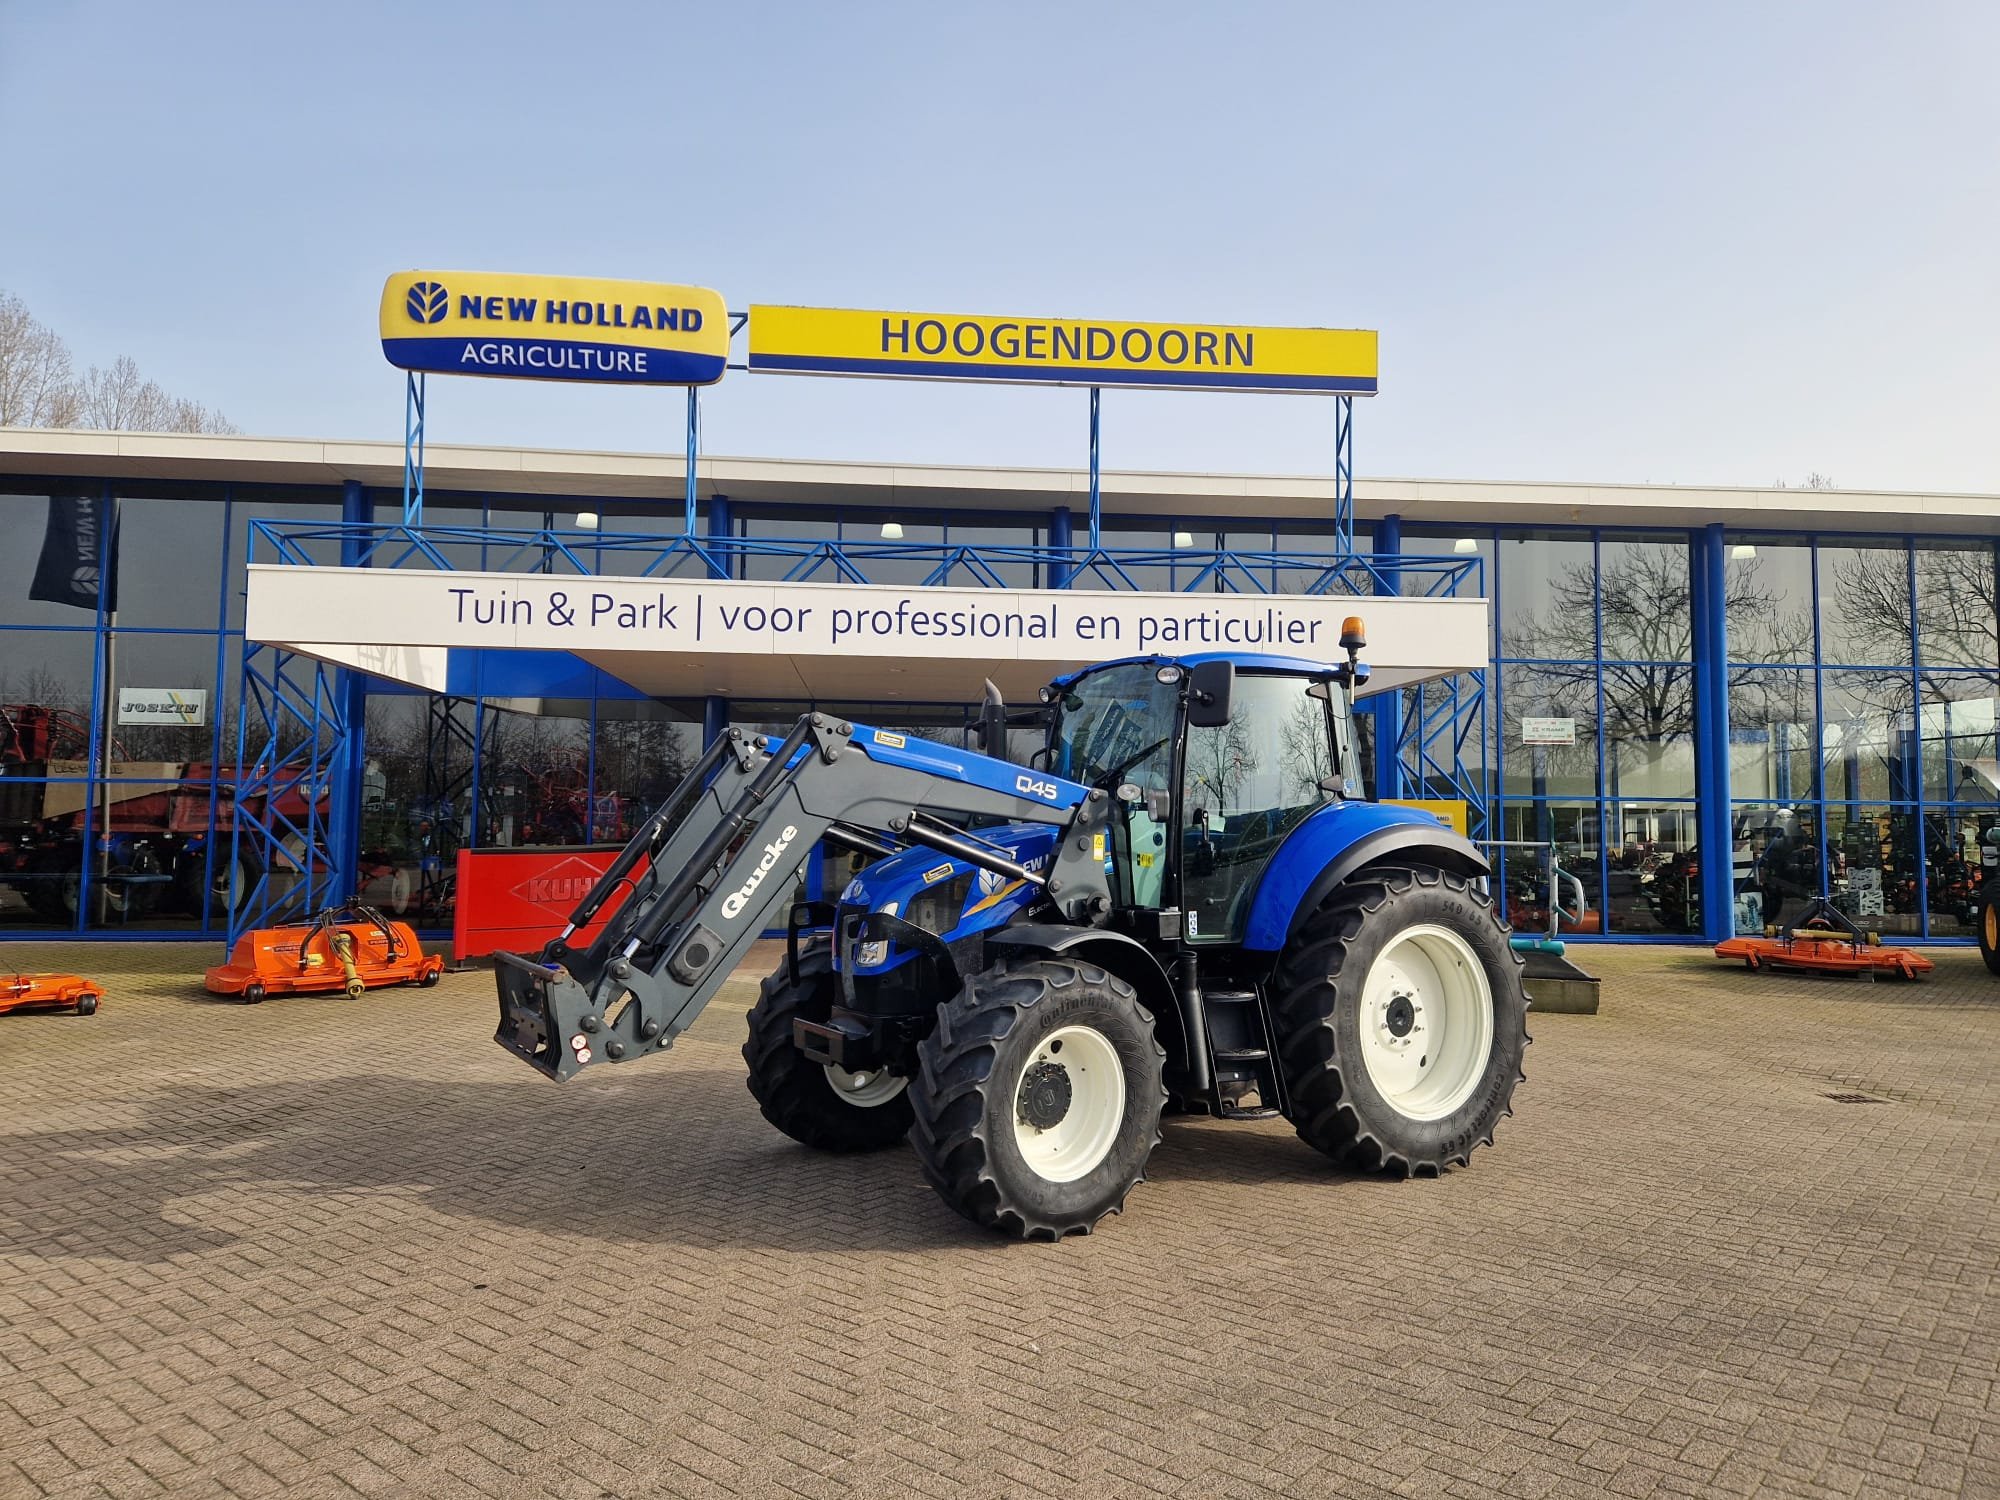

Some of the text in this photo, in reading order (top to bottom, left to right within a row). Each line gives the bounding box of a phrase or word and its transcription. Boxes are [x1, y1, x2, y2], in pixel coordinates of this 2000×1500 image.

[459, 294, 703, 333] NEW HOLLAND
[461, 342, 648, 373] AGRICULTURE
[881, 317, 1255, 367] HOOGENDOORN
[448, 588, 533, 626] Tuin
[546, 591, 576, 627] &
[590, 592, 679, 630] Park
[718, 604, 813, 633] voor
[831, 600, 1058, 643] professional
[1074, 612, 1121, 640] en
[1138, 608, 1323, 651] particulier
[121, 702, 199, 714] JOSKIN
[1016, 775, 1057, 800] Q45
[721, 825, 798, 919] Quicke
[1021, 855, 1043, 873] EW
